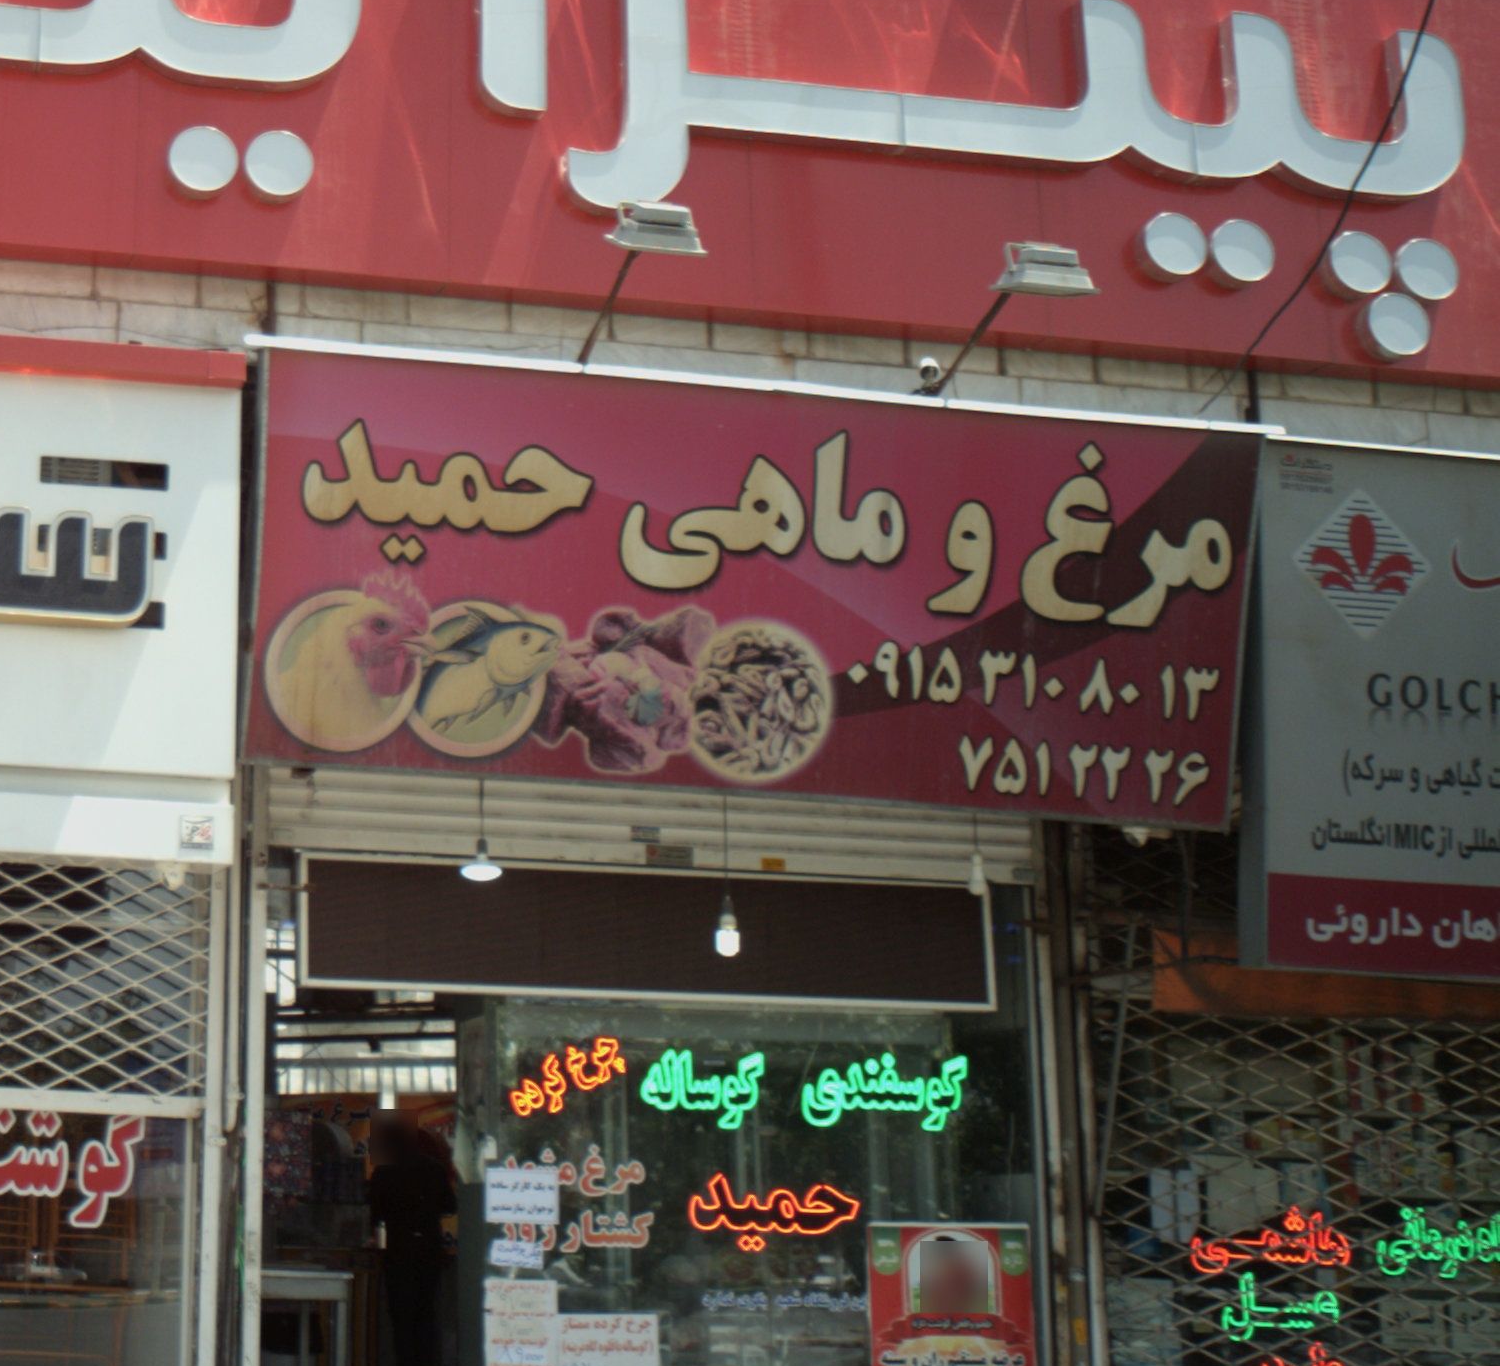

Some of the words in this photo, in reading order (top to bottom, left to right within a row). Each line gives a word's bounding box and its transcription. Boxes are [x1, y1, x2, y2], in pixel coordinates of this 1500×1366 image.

[301, 418, 594, 564] حمید
[619, 429, 908, 590] ماهی
[926, 498, 994, 614] و
[1021, 441, 1233, 627] مرغ
[847, 640, 962, 704] ۰۹۱۵
[1158, 663, 1220, 722] ۱۳
[957, 734, 1052, 797] ۷۵۱
[1068, 741, 1131, 802] ۲۲
[1143, 748, 1211, 807] ۲۶
[1409, 766, 1422, 793] و
[1425, 756, 1484, 797] گیاهی
[1311, 815, 1393, 852] انگلستان
[1394, 822, 1434, 850] MIC
[640, 1047, 765, 1130] گوساله
[800, 1051, 970, 1131] گوسفندی
[580, 1143, 648, 1197] مرغ
[559, 1208, 655, 1253] کشتار
[688, 1172, 861, 1251] حمید
